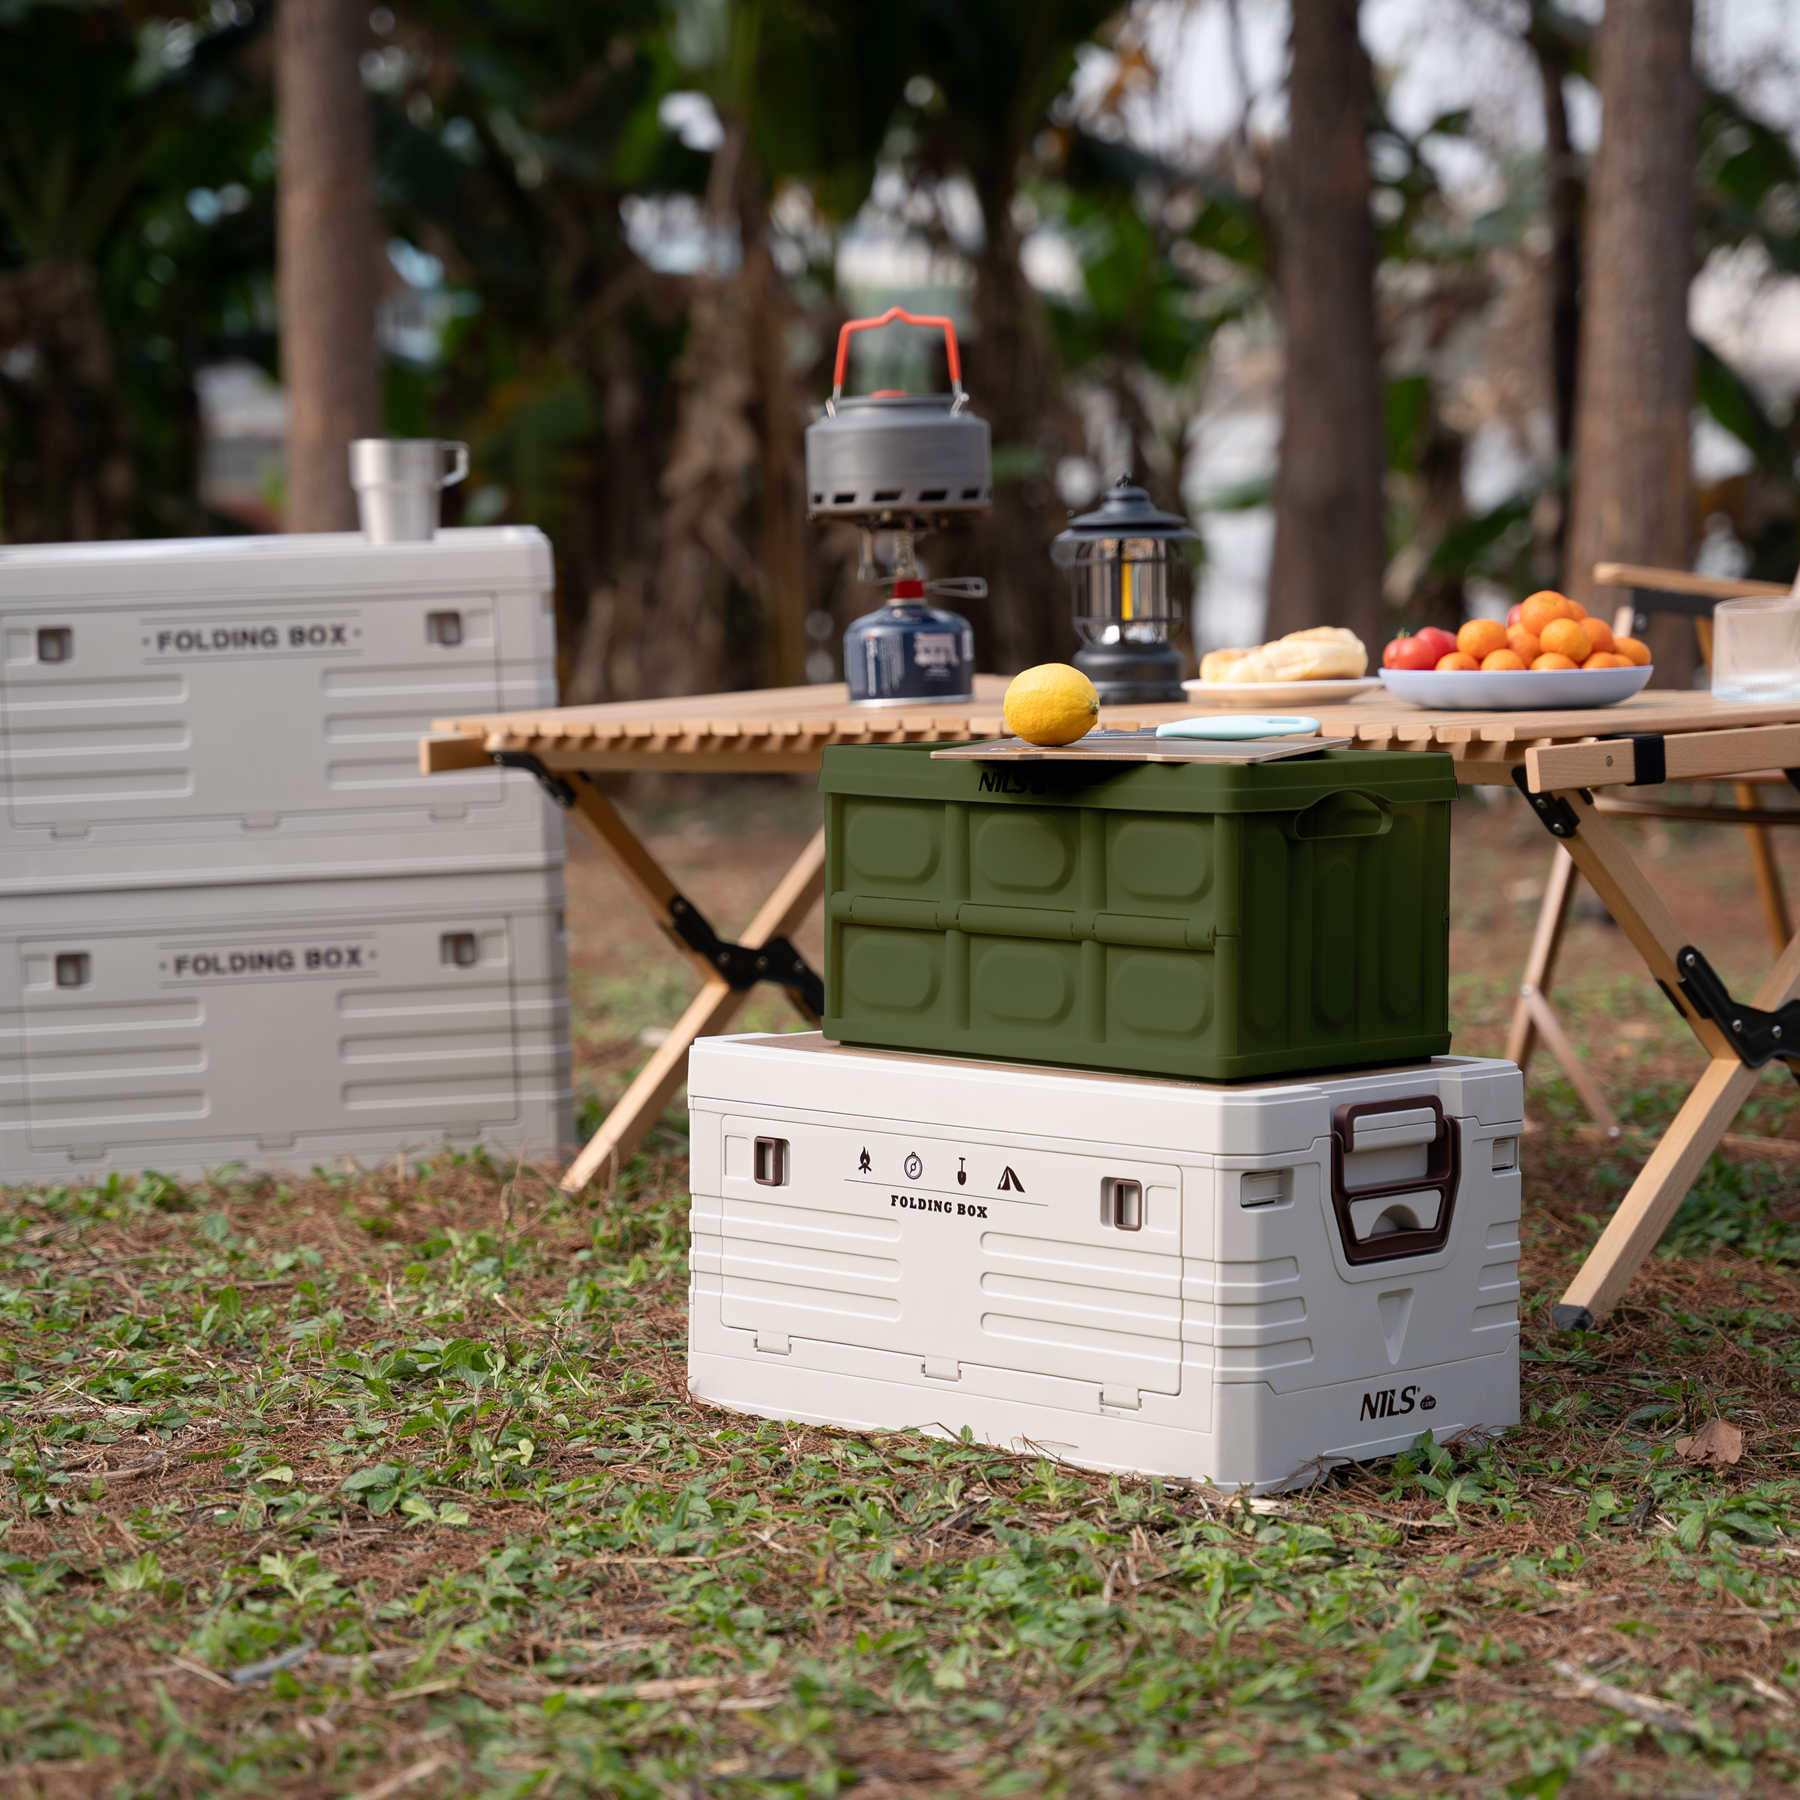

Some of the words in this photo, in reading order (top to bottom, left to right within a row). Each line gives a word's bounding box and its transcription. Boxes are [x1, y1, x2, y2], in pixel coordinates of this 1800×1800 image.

[156, 626, 279, 652] FOLDING
[289, 624, 347, 647] BOX
[978, 772, 1027, 793] NILS
[174, 949, 296, 976] FOLDING
[304, 945, 363, 969] BOX
[891, 1195, 952, 1213] FOLDING
[957, 1203, 987, 1218] BOX
